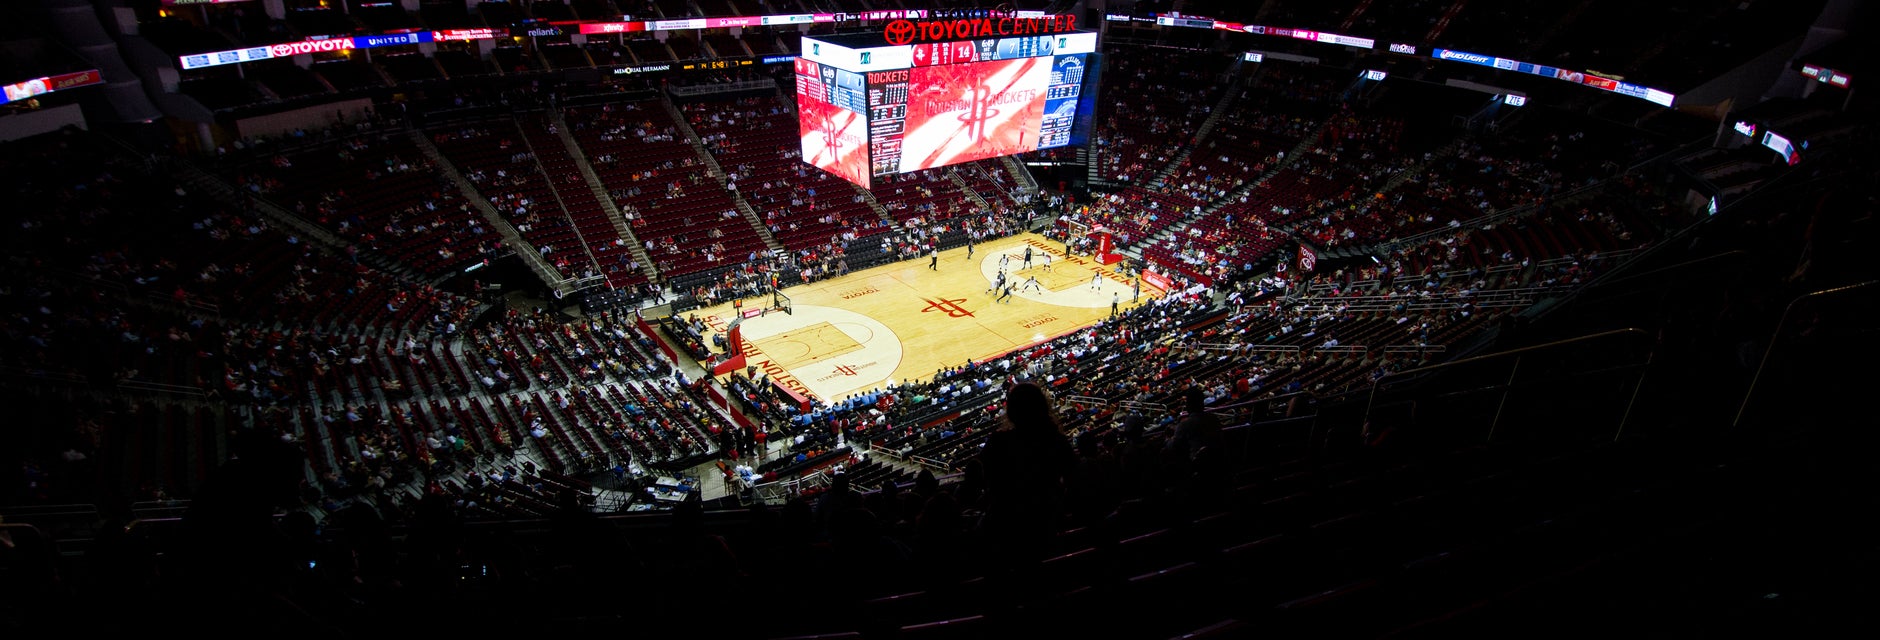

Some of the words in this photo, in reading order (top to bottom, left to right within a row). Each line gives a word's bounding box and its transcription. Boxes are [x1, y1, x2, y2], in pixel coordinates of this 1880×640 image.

[528, 28, 554, 36] reliant
[603, 24, 624, 32] xfinity
[918, 19, 993, 40] TOYOTA
[999, 14, 1076, 35] CENTER
[291, 38, 355, 53] TOYOTA
[368, 36, 407, 45] UNITED
[958, 46, 970, 58] 14
[1009, 43, 1015, 54] 7
[1248, 53, 1258, 61] ZTE
[1446, 51, 1464, 59] BUD
[1463, 54, 1488, 63] LIGHT
[614, 67, 642, 75] MEMORIAL
[642, 65, 670, 73] HERMANN
[806, 62, 817, 76] 14
[868, 70, 909, 84] ROCKETS
[1371, 71, 1382, 79] ZTE
[925, 99, 971, 116] HOUSTON
[989, 88, 1037, 107] ROCKETS
[1509, 95, 1521, 105] ZTE
[1021, 237, 1089, 266] HOUSTON
[842, 288, 880, 299] TOYOTA
[1022, 316, 1058, 328] TOYOTA
